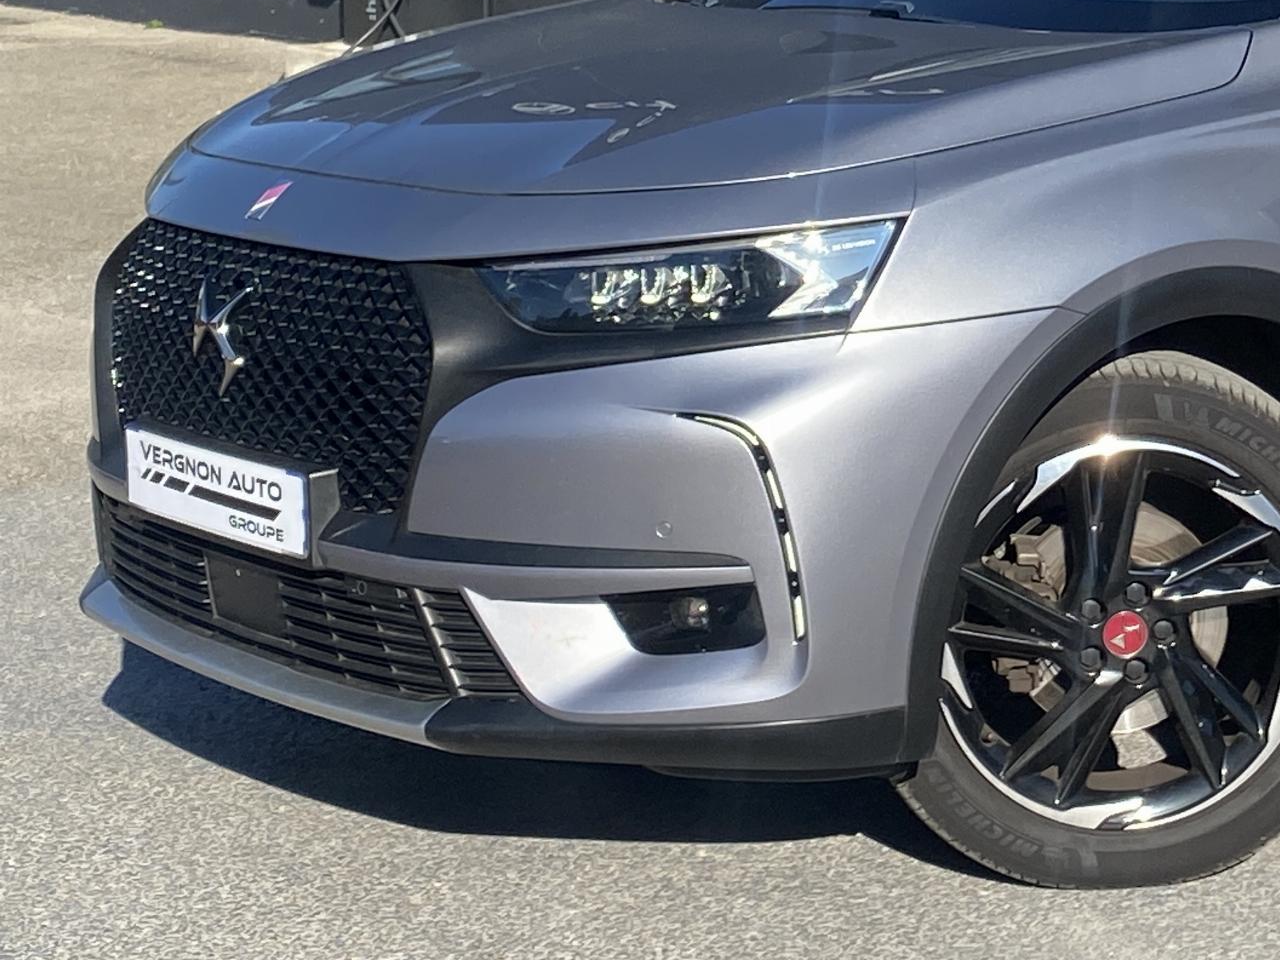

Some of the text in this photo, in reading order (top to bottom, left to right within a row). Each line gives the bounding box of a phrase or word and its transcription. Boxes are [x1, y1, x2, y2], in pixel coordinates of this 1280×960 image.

[140, 440, 282, 502] VERGNON AUTO
[229, 515, 285, 542] GROUPE
[925, 768, 1040, 858] MICHELIN
